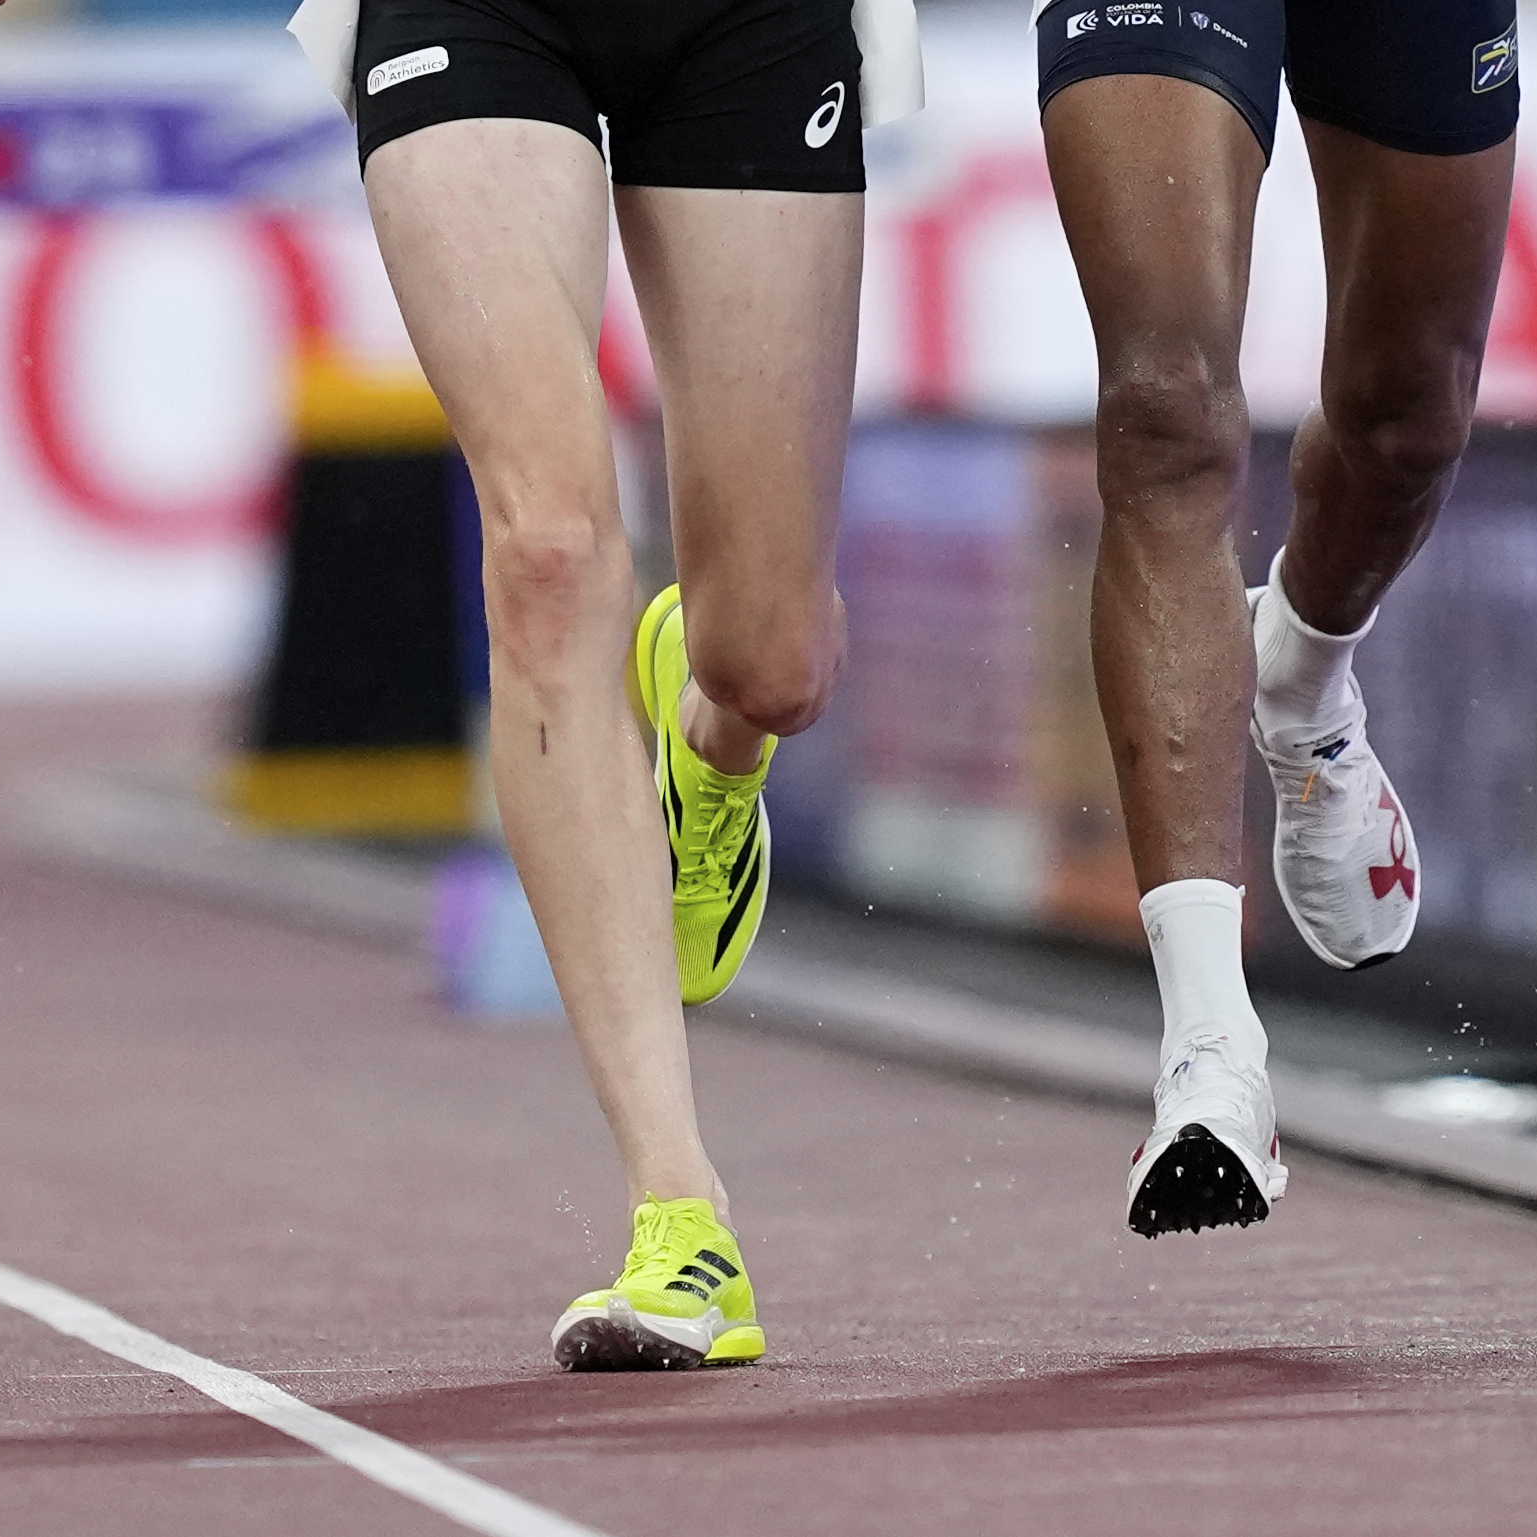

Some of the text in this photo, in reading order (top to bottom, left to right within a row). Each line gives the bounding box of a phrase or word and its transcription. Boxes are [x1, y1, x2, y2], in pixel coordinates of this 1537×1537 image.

[1106, 3, 1163, 13] COLOMBIA
[1106, 13, 1164, 27] VIDA
[1213, 22, 1249, 49] Deporte
[388, 56, 420, 71] Belgian
[389, 60, 445, 82] Athletics
